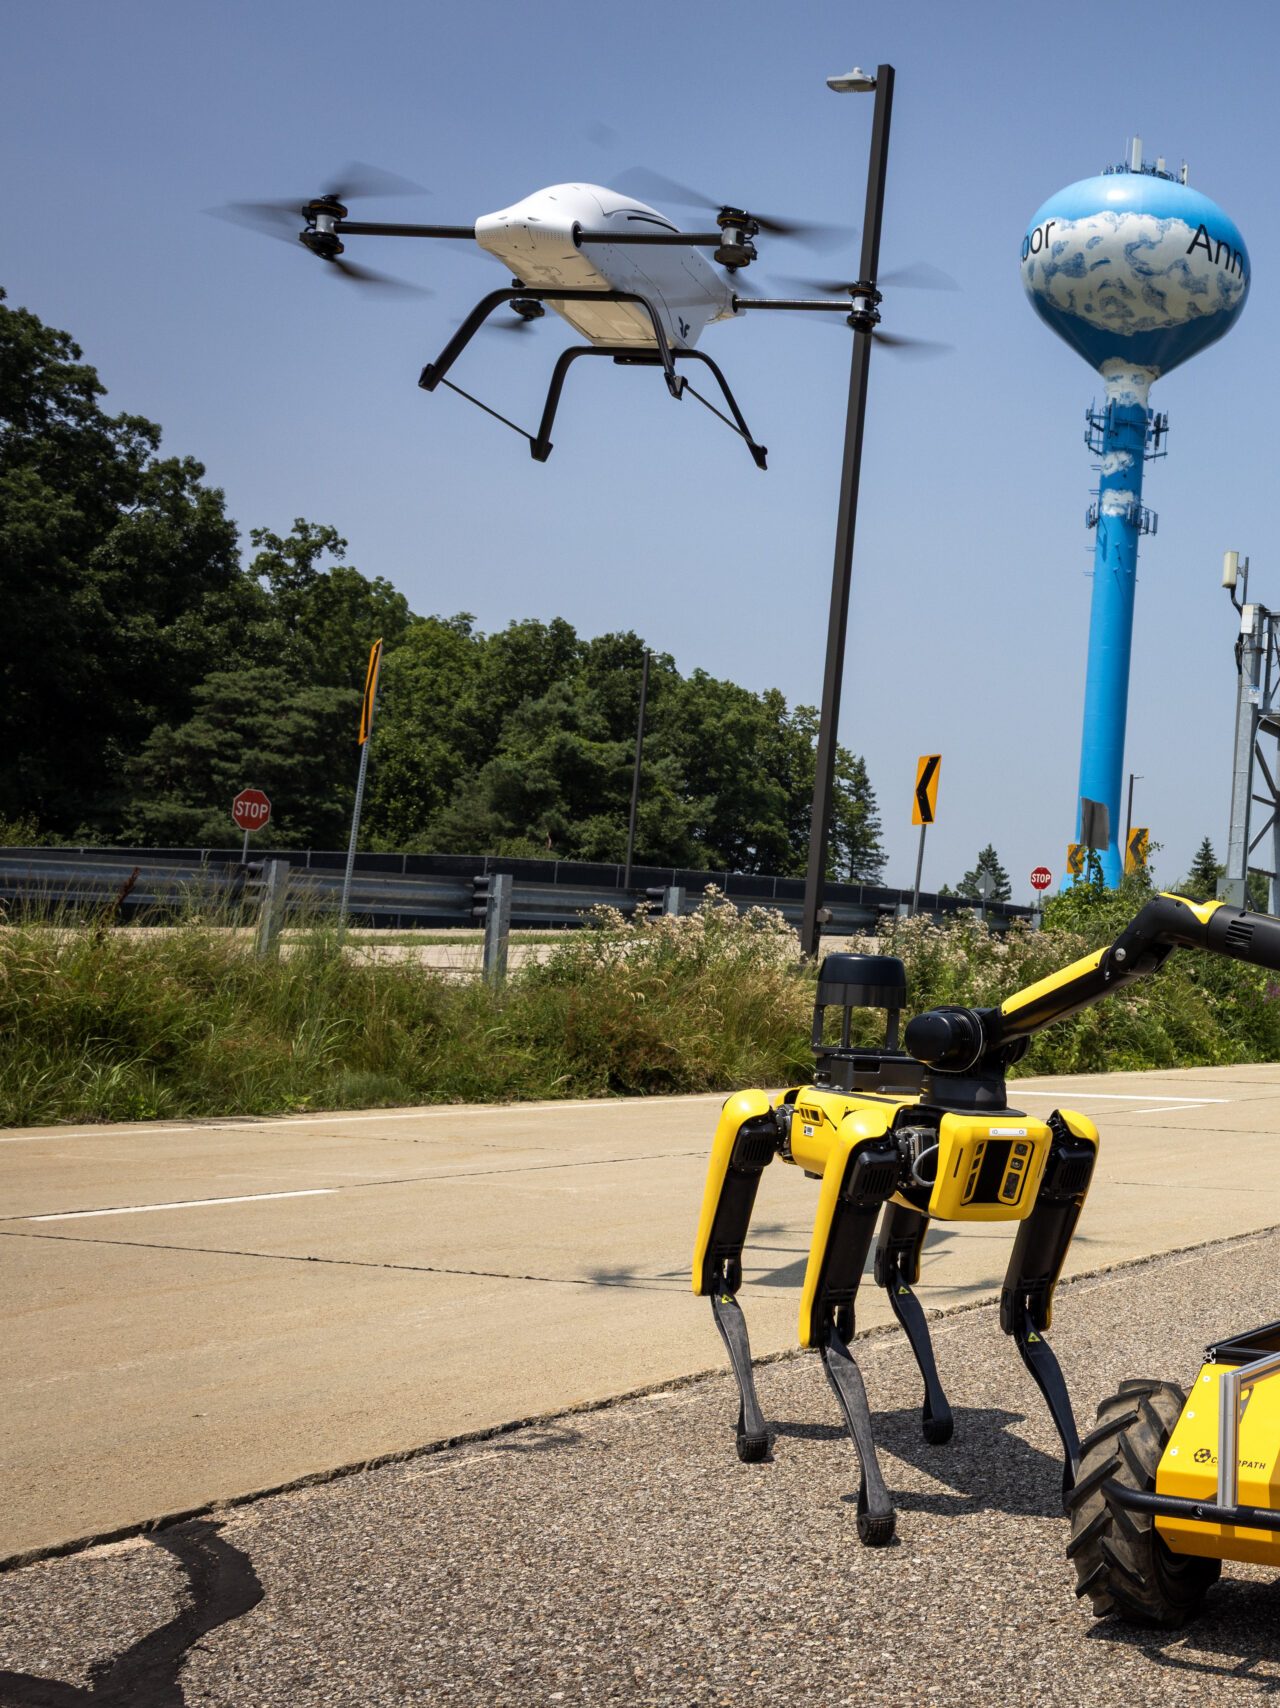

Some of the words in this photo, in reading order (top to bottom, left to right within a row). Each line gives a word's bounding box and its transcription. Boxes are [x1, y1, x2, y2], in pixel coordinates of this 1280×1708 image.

[1186, 224, 1245, 279] Ann
[235, 800, 268, 819] STOP
[1031, 873, 1051, 883] STOP
[1211, 1456, 1266, 1470] CPATH
